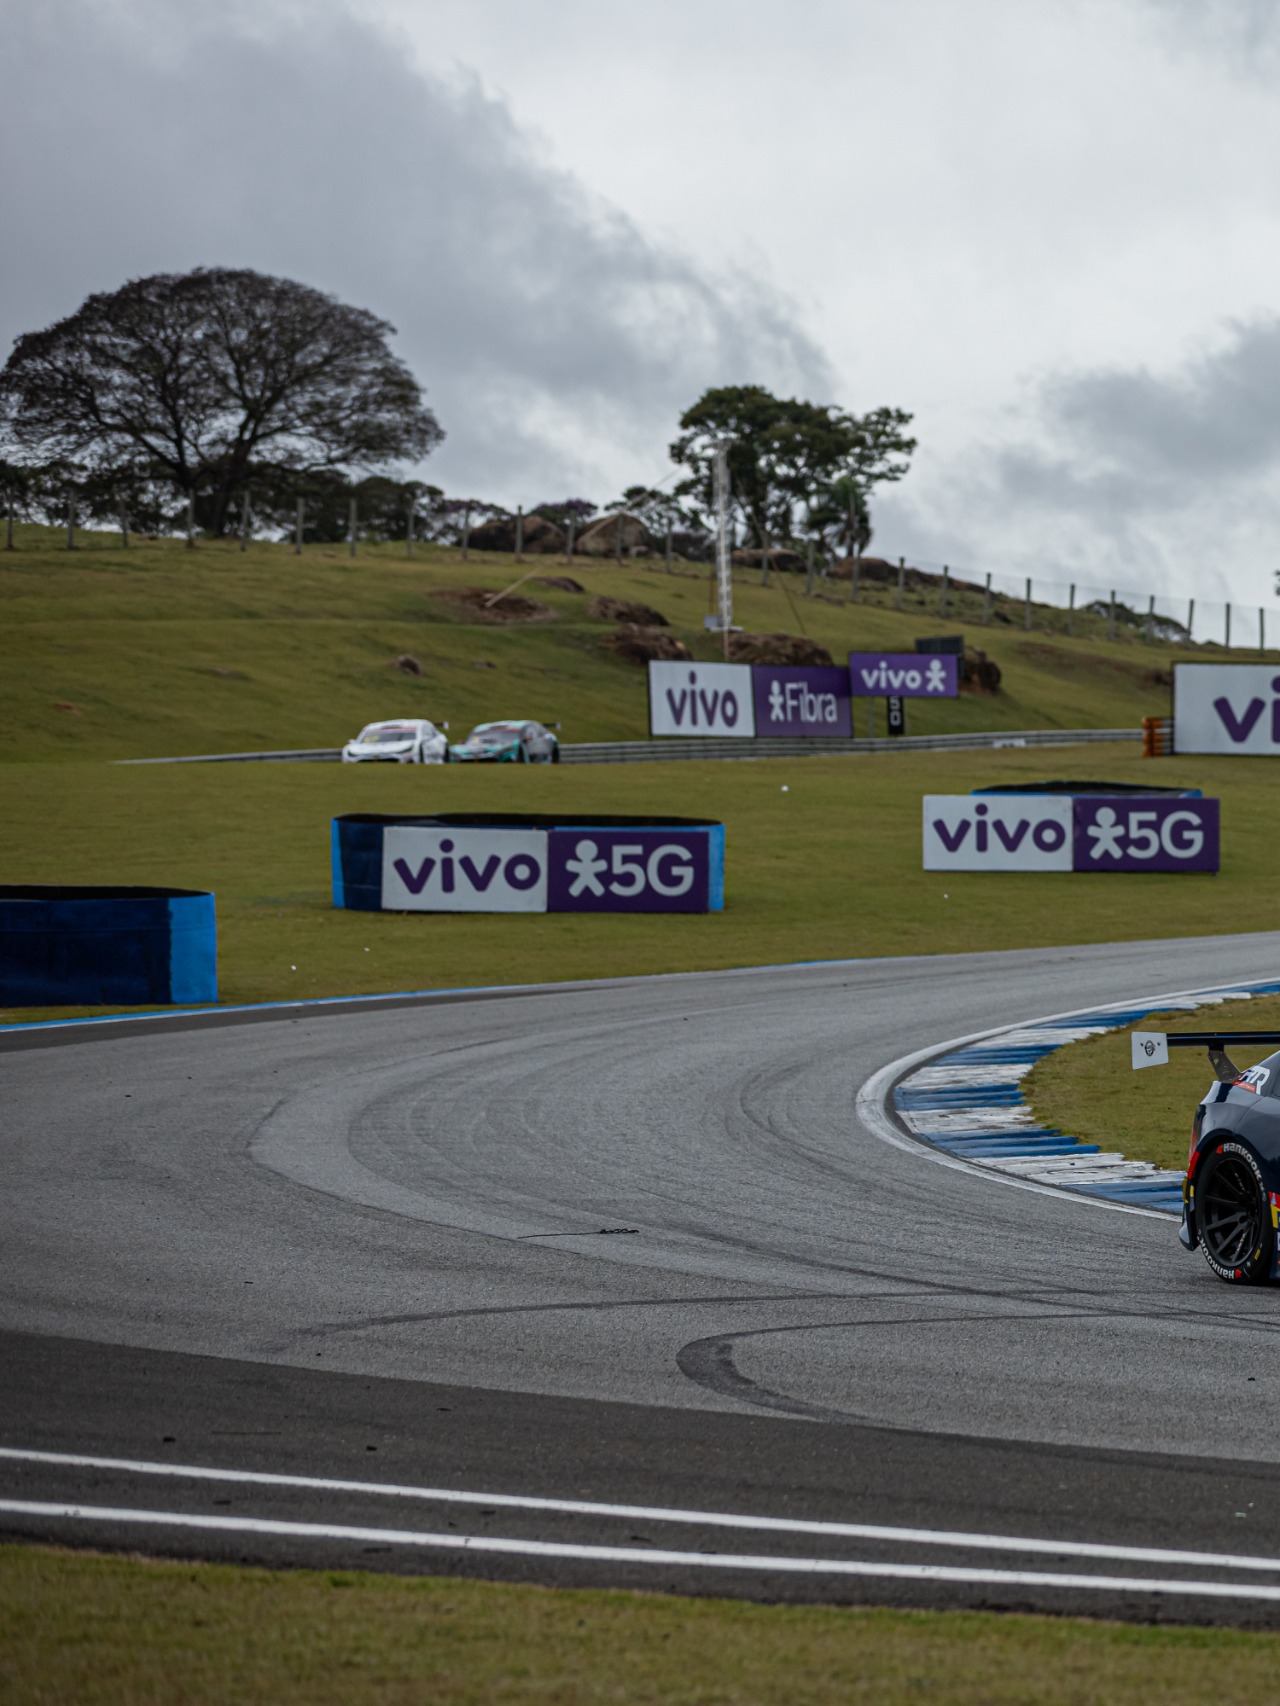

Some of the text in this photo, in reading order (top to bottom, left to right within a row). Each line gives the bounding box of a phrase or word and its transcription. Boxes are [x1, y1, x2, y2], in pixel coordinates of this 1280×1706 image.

[666, 670, 738, 727] vivo
[861, 661, 922, 689] vivo
[785, 682, 838, 723] Fibra
[932, 803, 1066, 853] vivo
[1126, 811, 1204, 859] 5G
[393, 839, 541, 894] vivo
[609, 844, 694, 897] 5G
